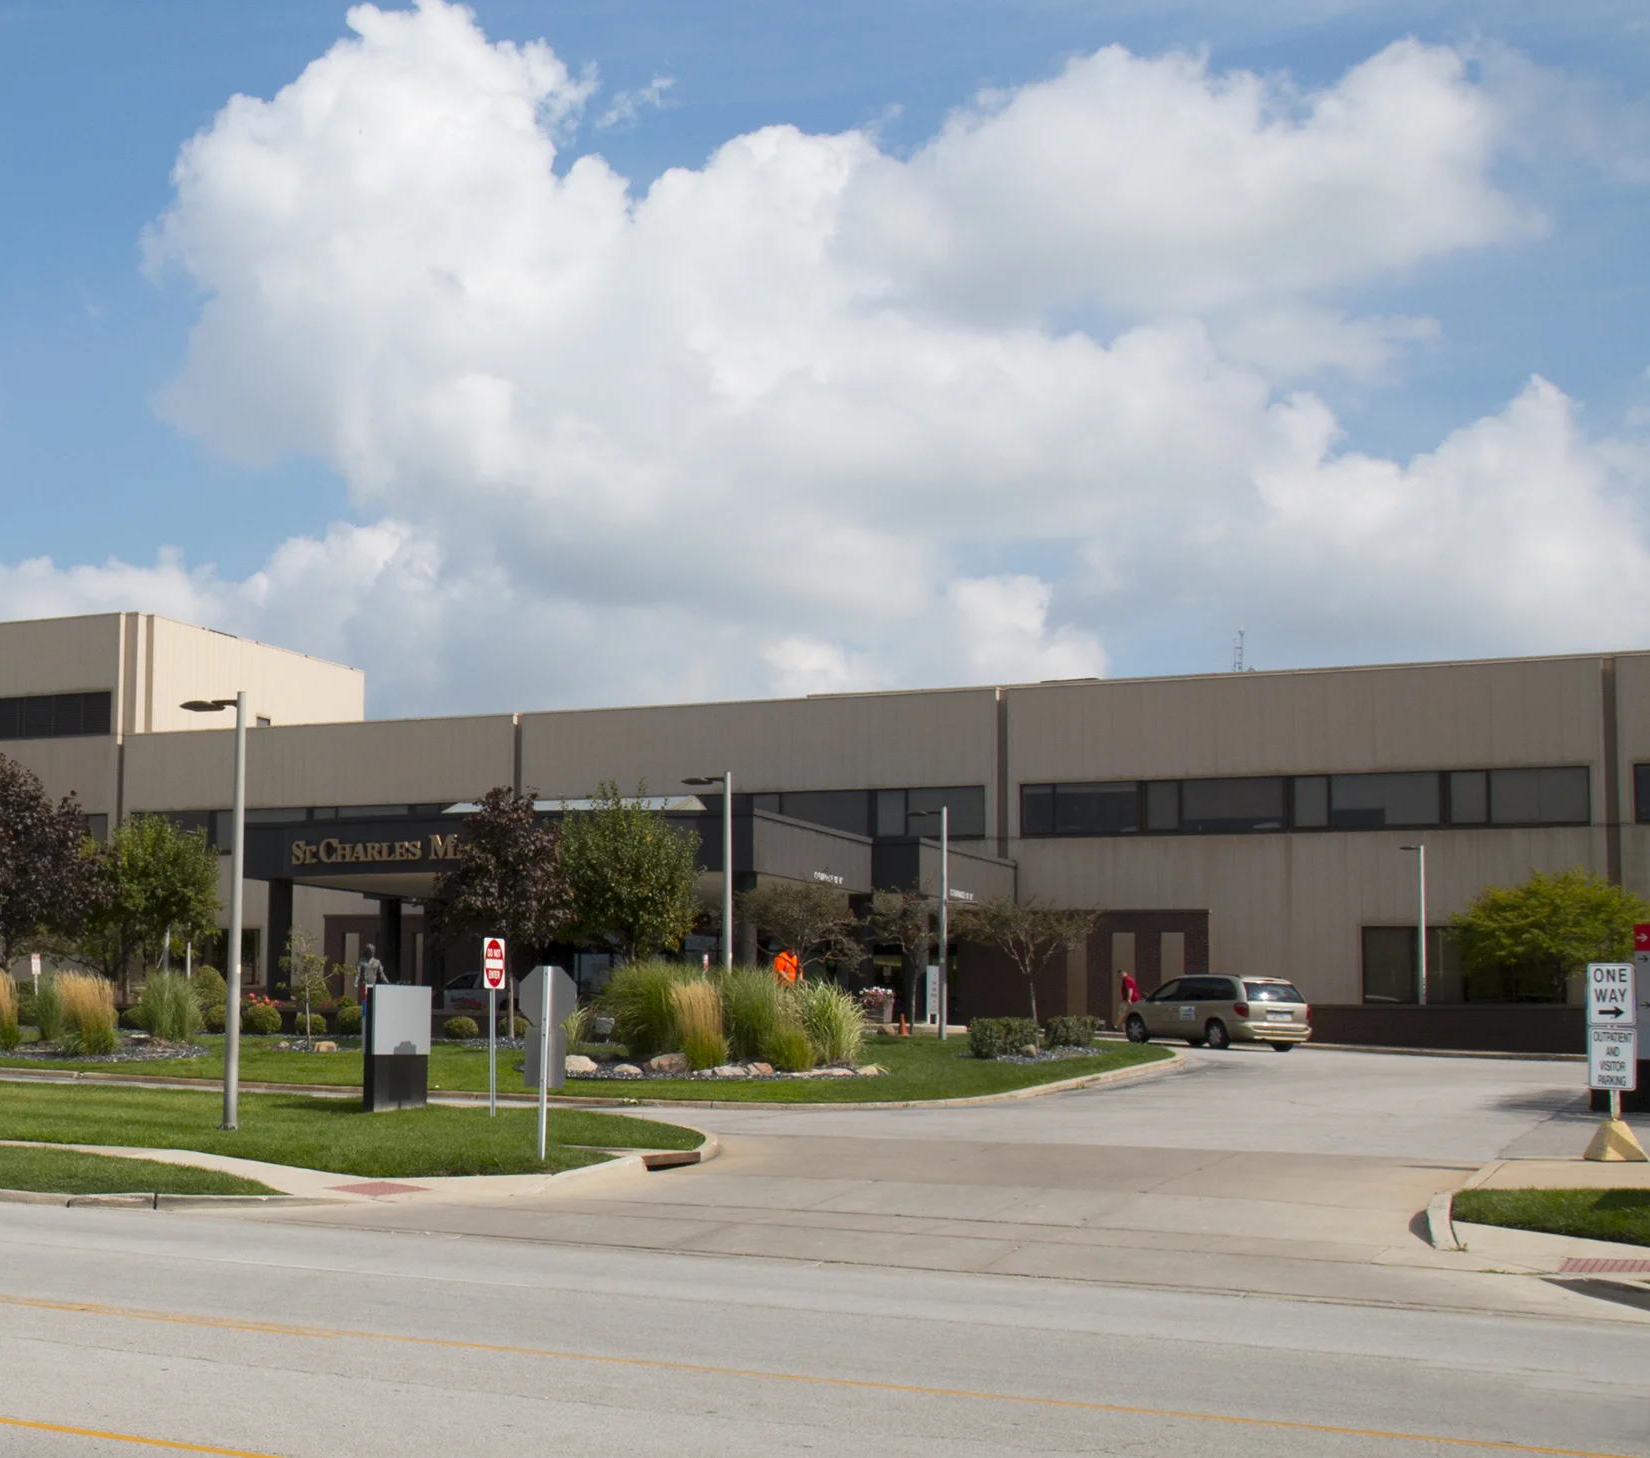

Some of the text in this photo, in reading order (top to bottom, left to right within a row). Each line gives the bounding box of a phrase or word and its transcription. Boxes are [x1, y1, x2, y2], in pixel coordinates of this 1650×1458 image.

[319, 838, 423, 863] CHARLES
[1593, 968, 1628, 983] ONE
[1593, 988, 1628, 1003] WAY
[1592, 1031, 1633, 1043] OUTPATIENT
[1606, 1046, 1621, 1057] AND
[1599, 1060, 1626, 1072] VISITOR
[1597, 1074, 1627, 1087] PARKING
